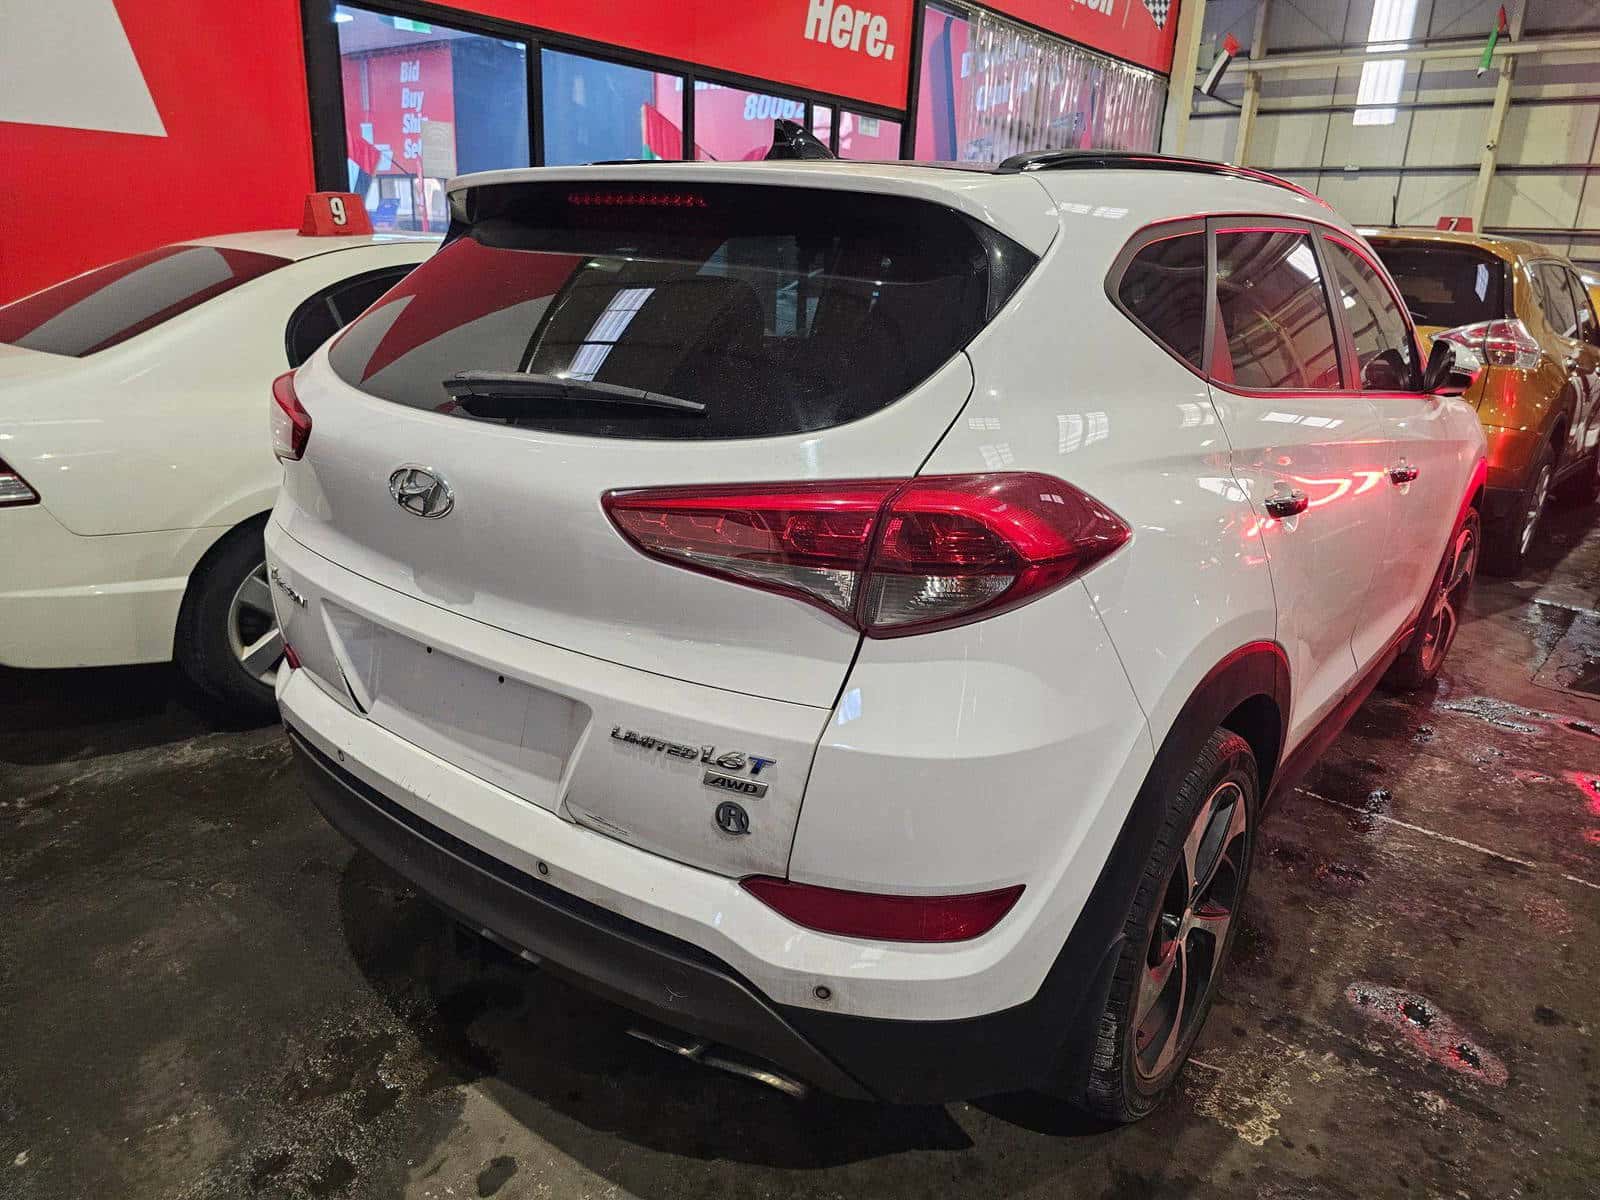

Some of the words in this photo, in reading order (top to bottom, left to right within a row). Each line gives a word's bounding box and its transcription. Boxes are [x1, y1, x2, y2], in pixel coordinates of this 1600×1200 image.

[804, 0, 895, 61] Here.
[400, 60, 419, 83] Bid
[401, 87, 424, 112] Buy
[403, 113, 428, 134] Shi
[404, 139, 423, 159] Sel
[329, 197, 347, 226] 9
[1447, 217, 1459, 232] 7
[610, 725, 699, 760] LIMITED
[709, 777, 759, 794] AWD
